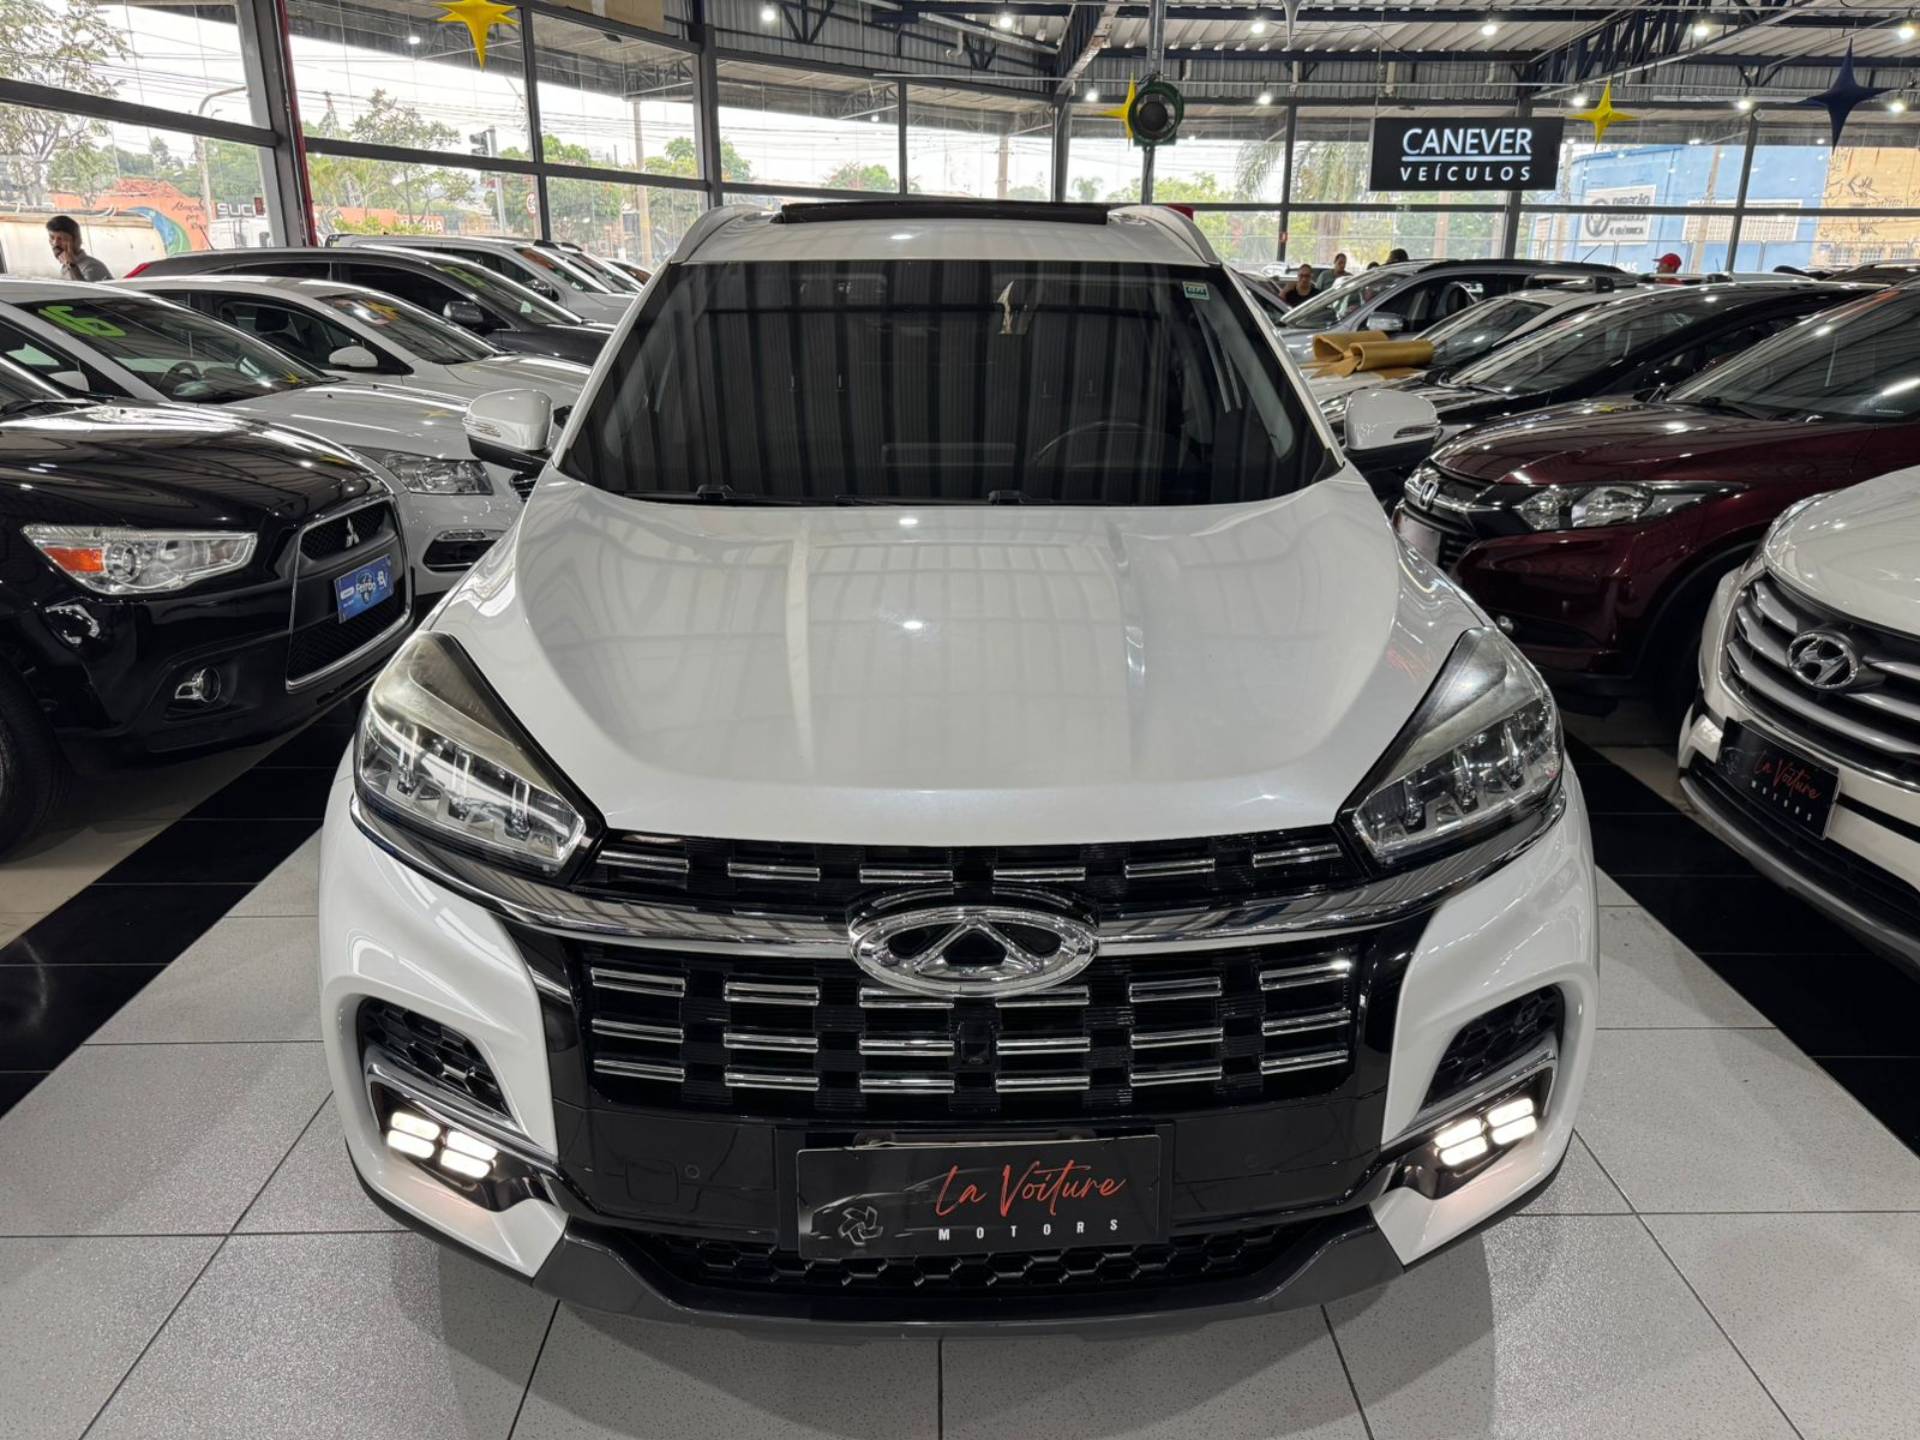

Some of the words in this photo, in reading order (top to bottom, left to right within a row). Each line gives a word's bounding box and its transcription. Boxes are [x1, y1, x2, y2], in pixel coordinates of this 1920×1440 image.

[1402, 127, 1533, 155] CANEVER
[1399, 163, 1532, 182] VEÍCULOS
[38, 305, 128, 337] 16
[935, 1164, 988, 1217] La
[1000, 1159, 1127, 1218] Voiture
[938, 1219, 1118, 1241] MOTORS
